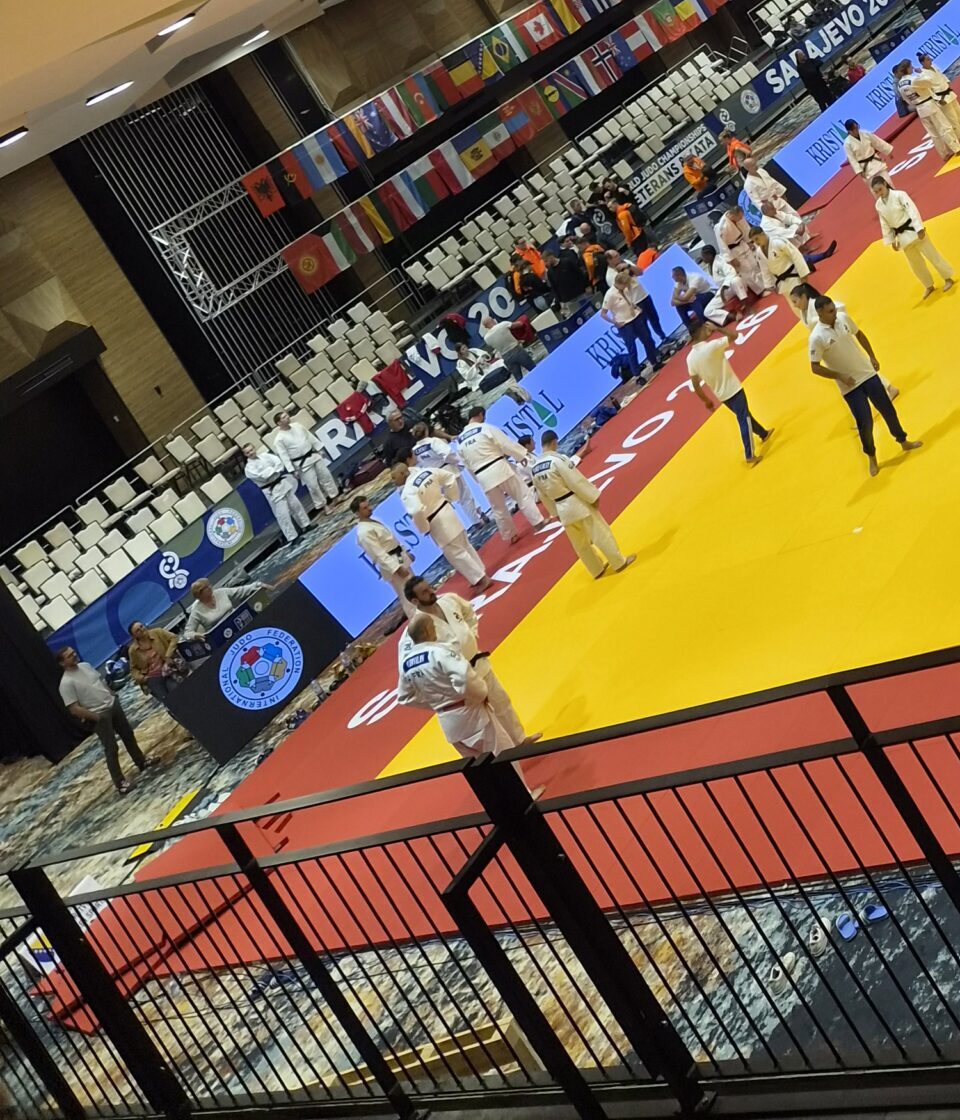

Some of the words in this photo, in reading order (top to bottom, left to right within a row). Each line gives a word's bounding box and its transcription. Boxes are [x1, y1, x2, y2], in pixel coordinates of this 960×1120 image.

[640, 162, 660, 182] JUDO
[657, 123, 707, 167] CHAMPIONSHIPS
[464, 437, 477, 448] FRA
[230, 634, 252, 656] JUDO
[266, 629, 301, 674] FEDERATION
[222, 667, 279, 708] INTERNATIONAL
